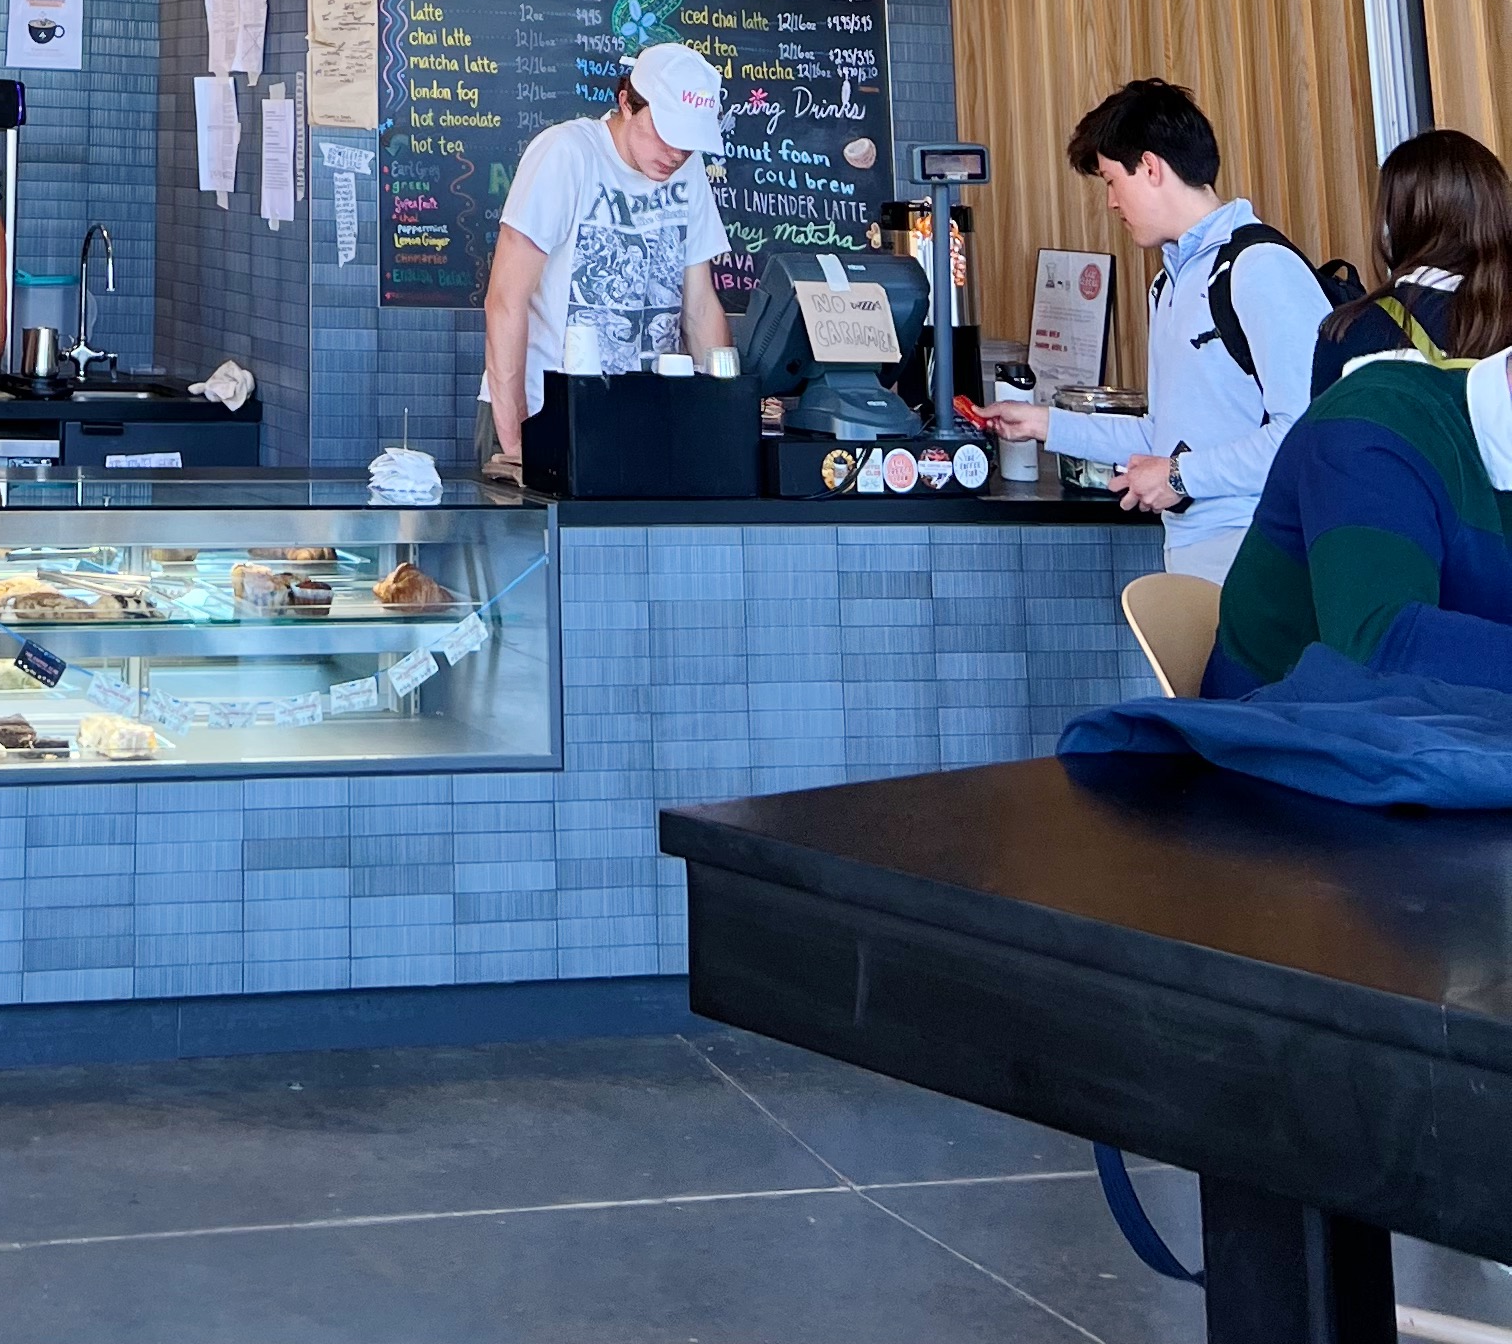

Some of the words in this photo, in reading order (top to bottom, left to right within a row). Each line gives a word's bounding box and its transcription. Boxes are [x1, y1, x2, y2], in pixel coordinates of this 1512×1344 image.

[410, 1, 443, 22] latte
[680, 6, 708, 25] iced
[713, 11, 737, 29] chai
[742, 14, 770, 31] latte
[409, 27, 437, 46] chai
[442, 28, 472, 47] latte
[714, 37, 738, 57] tea
[409, 55, 459, 72] matcha
[464, 56, 499, 74] latte
[714, 58, 732, 79] ed
[742, 59, 795, 82] matcha
[410, 79, 451, 101] london
[456, 80, 479, 108] fog
[792, 85, 866, 120] Drinks
[410, 106, 434, 129] hot
[439, 109, 501, 128] chocolate
[410, 134, 434, 154] hot
[439, 136, 464, 155] tea
[778, 139, 831, 167] foam
[391, 160, 415, 178] Earl
[416, 161, 440, 182] Grey
[805, 172, 855, 196] brew
[712, 186, 736, 209] NEY
[744, 189, 818, 220] LAVENDER
[824, 199, 868, 224] LATTE
[394, 232, 421, 249] Lemon
[421, 232, 451, 251] Ginger
[725, 222, 768, 253] ney
[711, 252, 754, 273] UAVA
[811, 293, 846, 314] NO
[814, 319, 898, 353] CARAMEL
